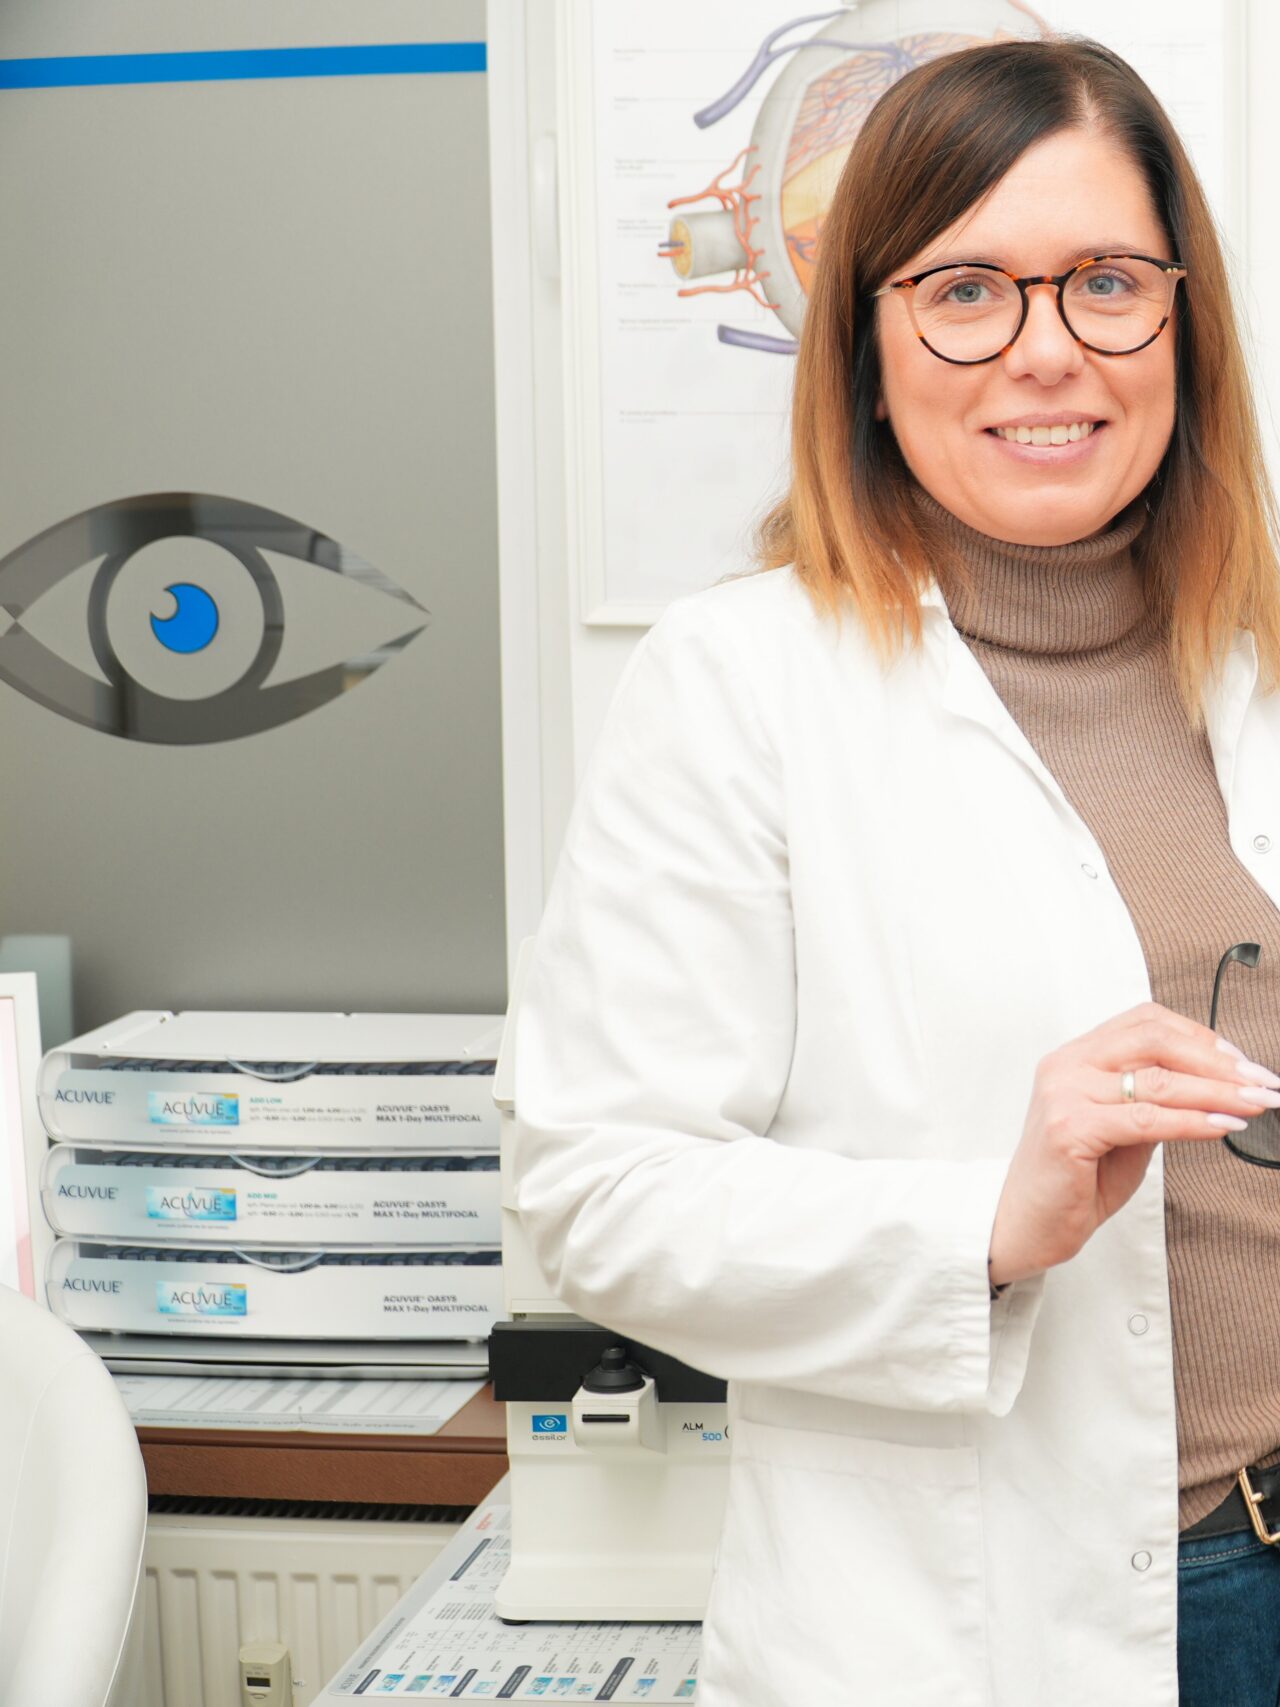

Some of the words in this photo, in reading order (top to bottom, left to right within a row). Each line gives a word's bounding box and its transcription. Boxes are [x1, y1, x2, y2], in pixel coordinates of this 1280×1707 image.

[162, 1100, 225, 1116] ACUVUE
[376, 1114, 397, 1122] MAX
[424, 1114, 483, 1123] MULTIFOCAL
[160, 1196, 222, 1212] ACUVUE
[373, 1210, 394, 1218] MAX
[421, 1210, 479, 1218] MULTIFOCAL
[170, 1290, 233, 1306] ACUVUE
[383, 1305, 405, 1313] MAX
[432, 1304, 489, 1313] MULTIFOCAL
[682, 1422, 704, 1431] ALM
[702, 1432, 722, 1441] 500
